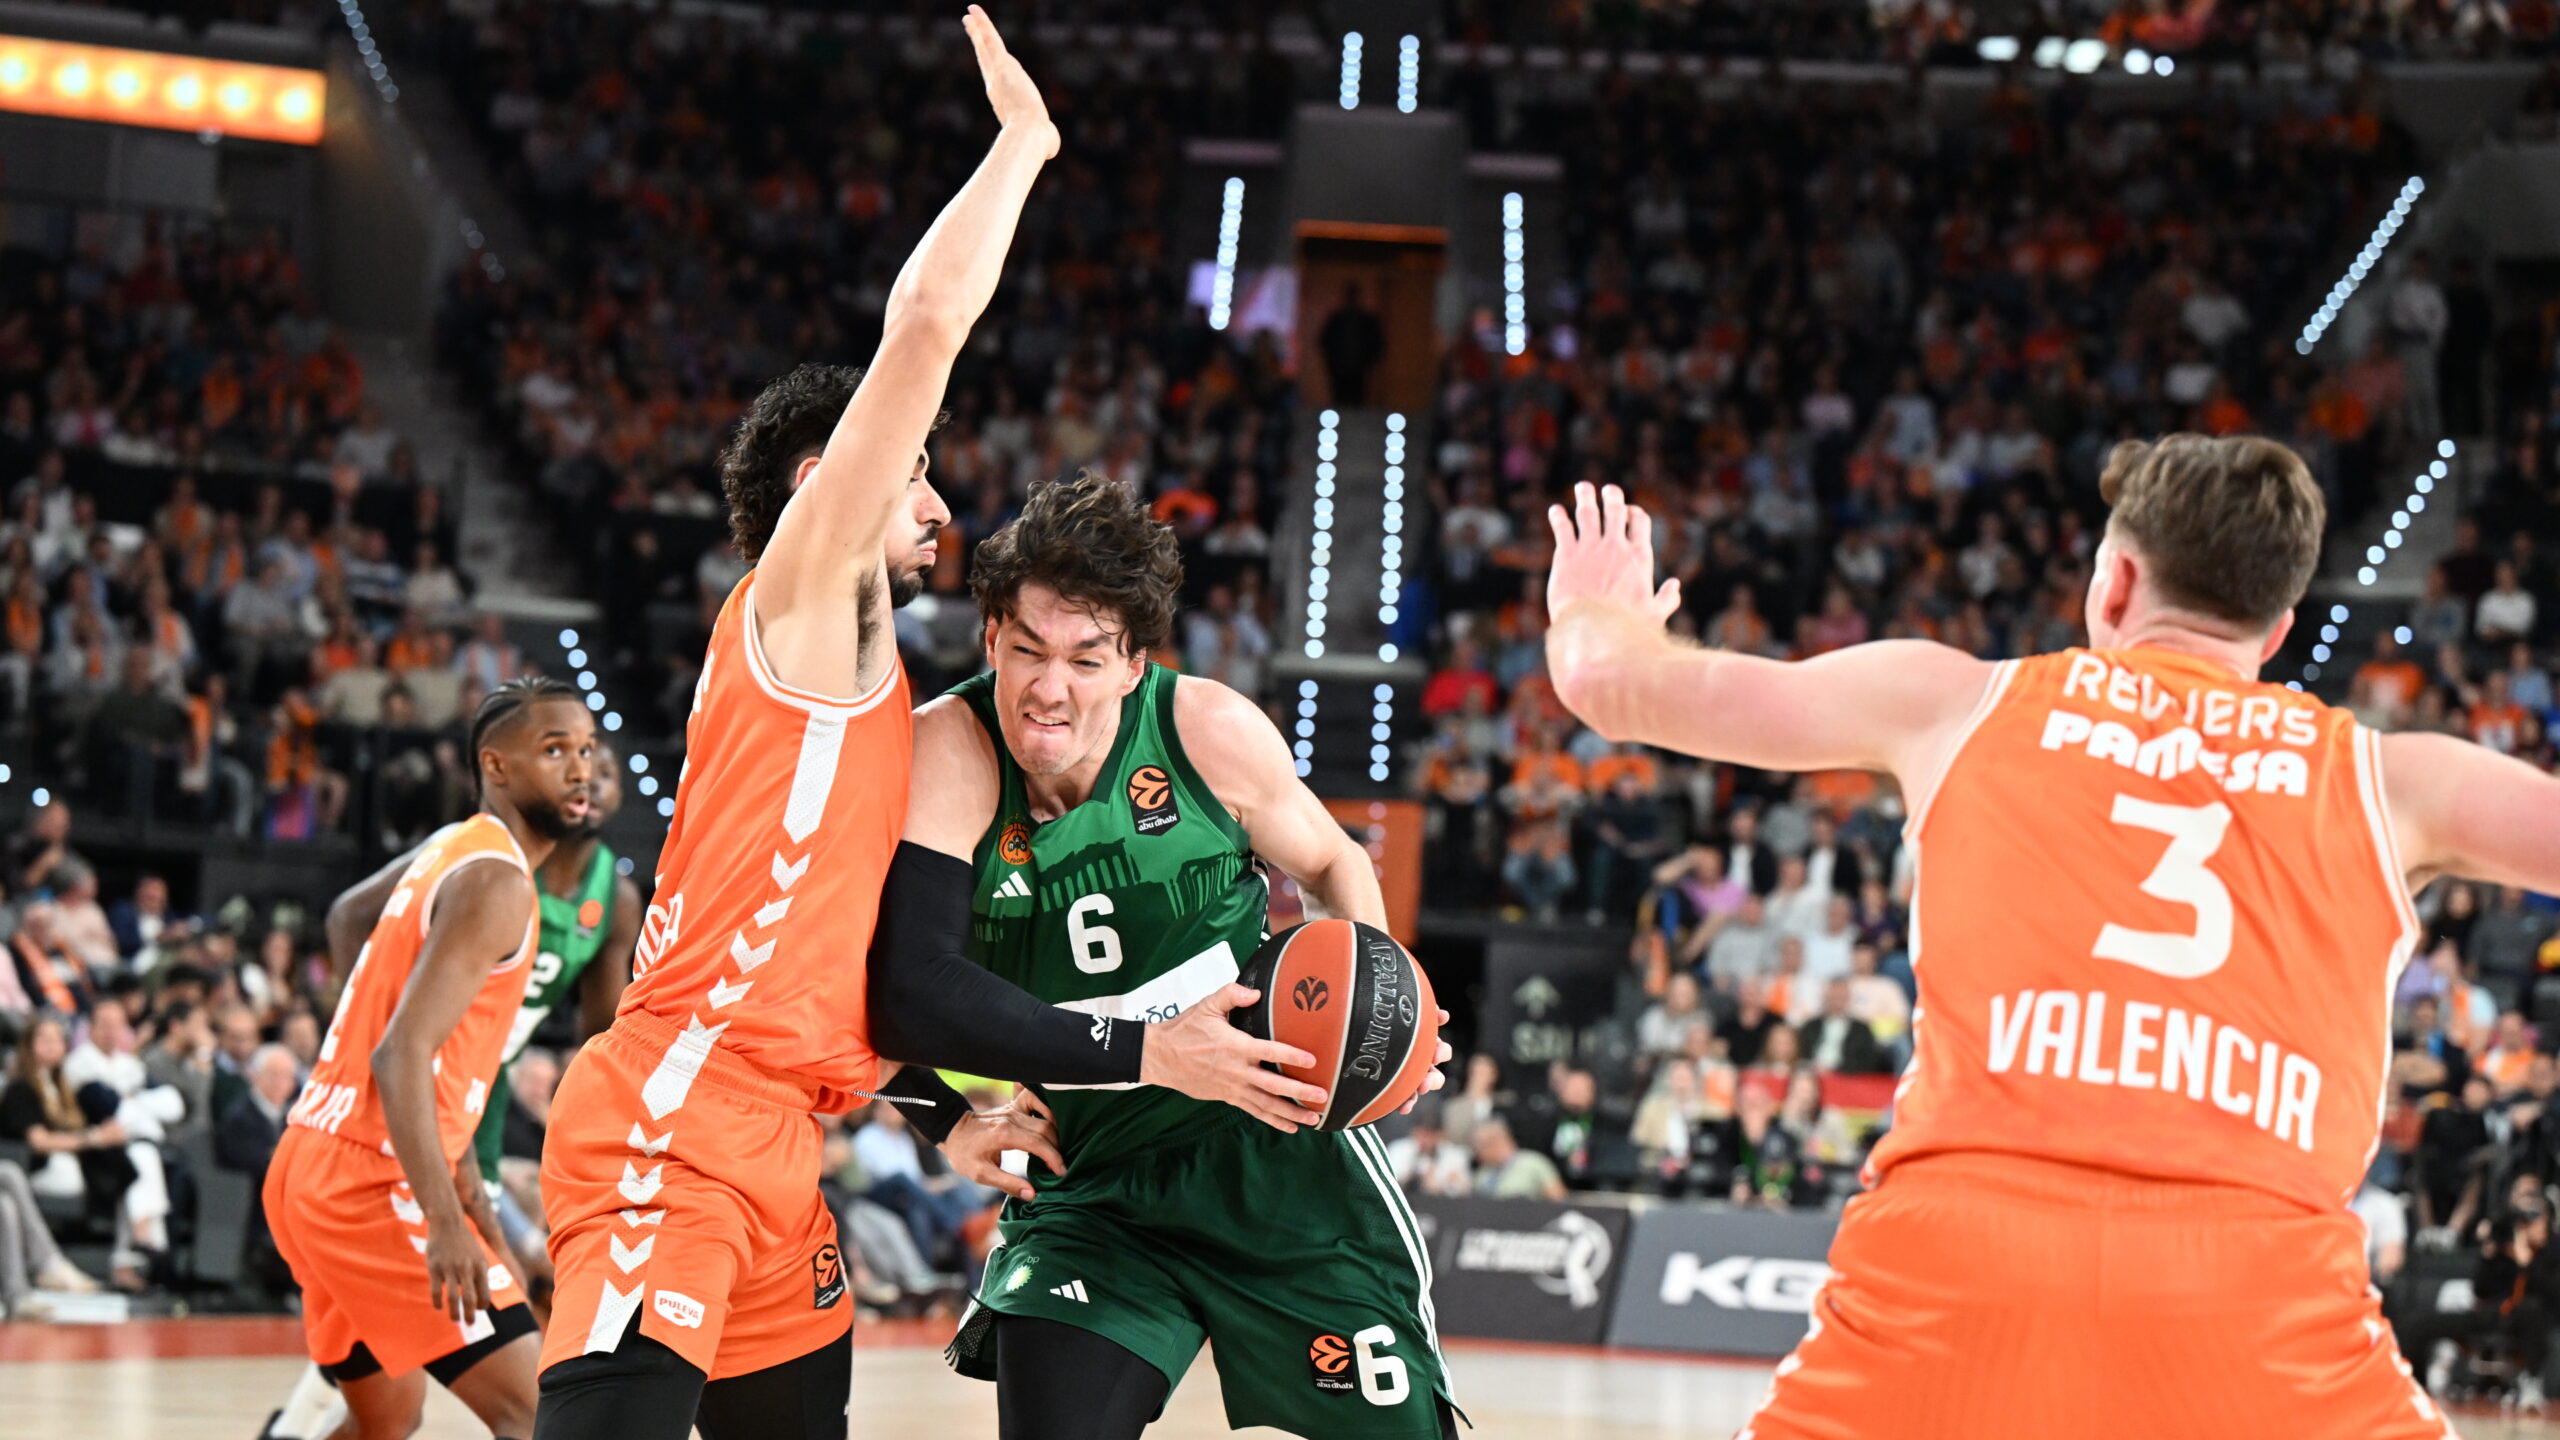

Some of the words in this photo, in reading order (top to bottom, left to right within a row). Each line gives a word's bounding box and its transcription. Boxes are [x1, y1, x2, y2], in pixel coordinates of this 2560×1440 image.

[2041, 709, 2309, 797] PAMESA
[1138, 821, 1154, 831] abu
[1154, 813, 1178, 827] dhabi
[2091, 792, 2234, 979] 3
[1067, 893, 1123, 974] 6
[1987, 989, 2322, 1152] VALENCIA
[1027, 1255, 1040, 1265] bp
[658, 1297, 699, 1320] PULEVA
[1353, 1324, 1410, 1406] 6
